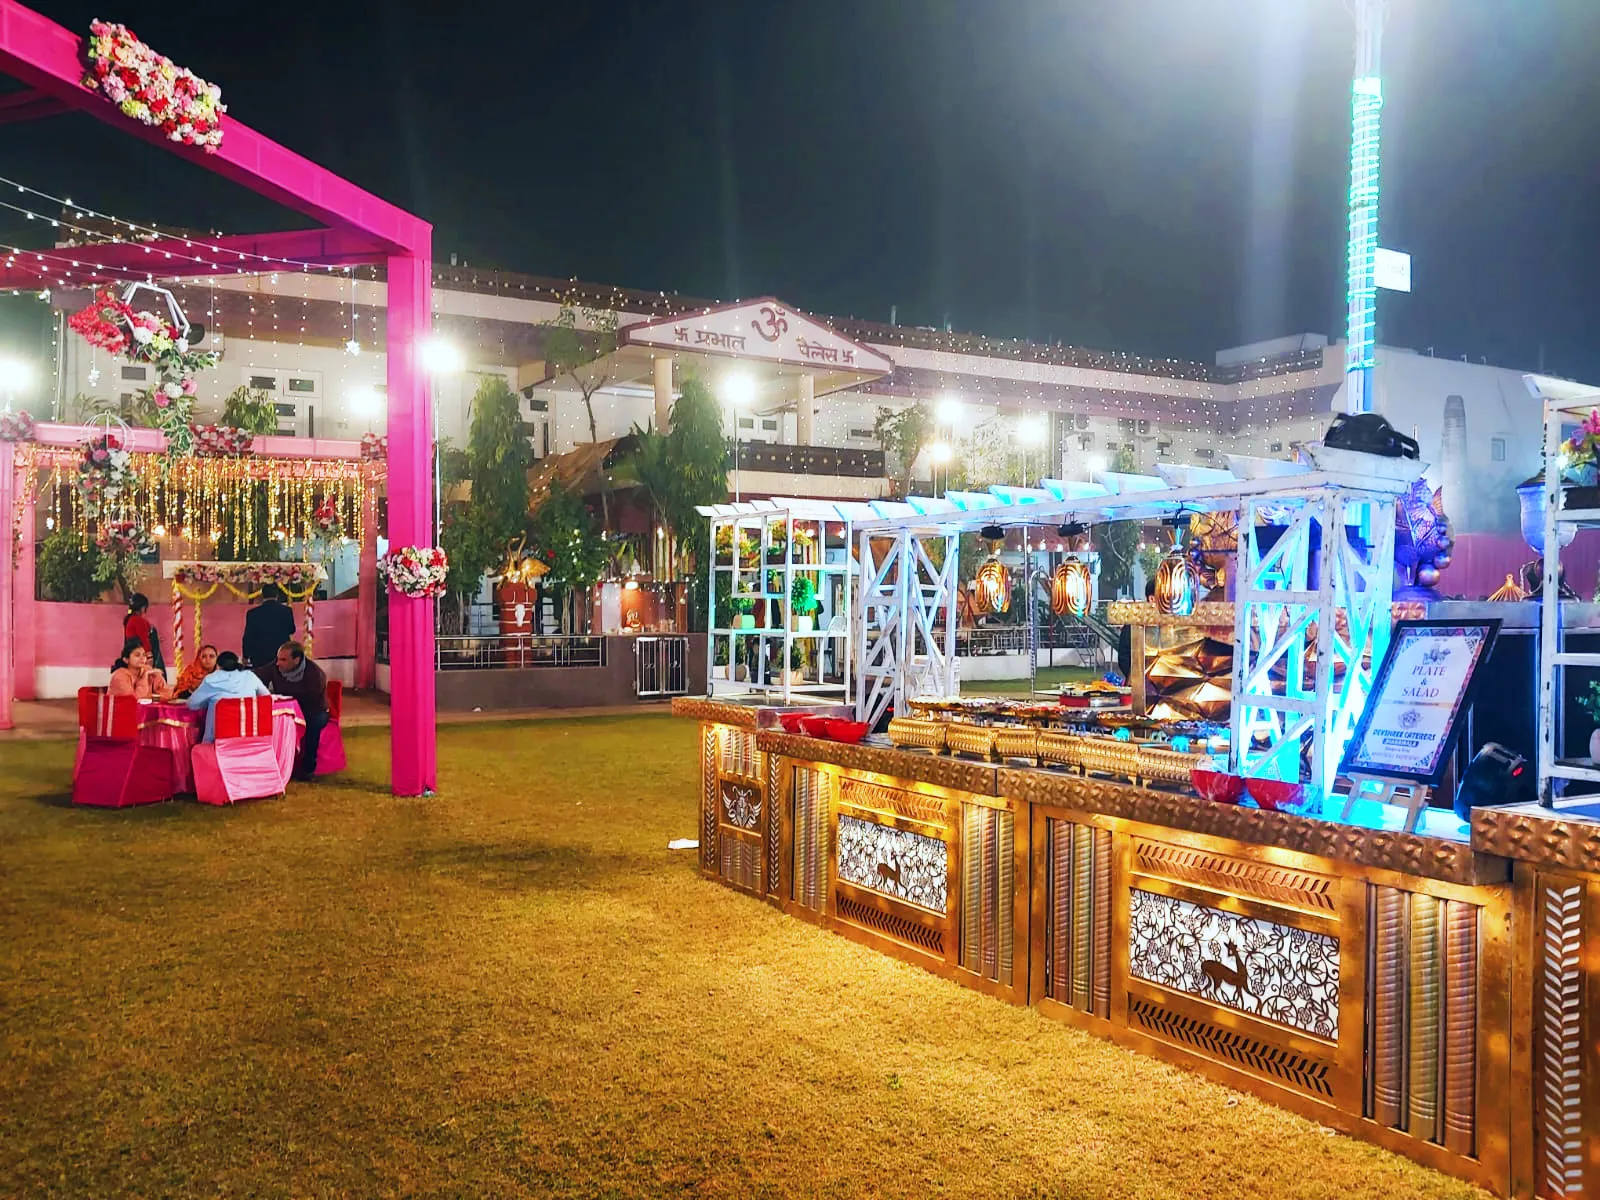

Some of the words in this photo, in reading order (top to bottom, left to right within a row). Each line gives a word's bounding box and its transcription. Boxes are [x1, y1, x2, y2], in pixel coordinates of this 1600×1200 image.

[695, 330, 746, 351] प्रभात
[1412, 665, 1446, 677] PLATE
[1420, 678, 1427, 686] &
[1401, 687, 1440, 698] SALAD
